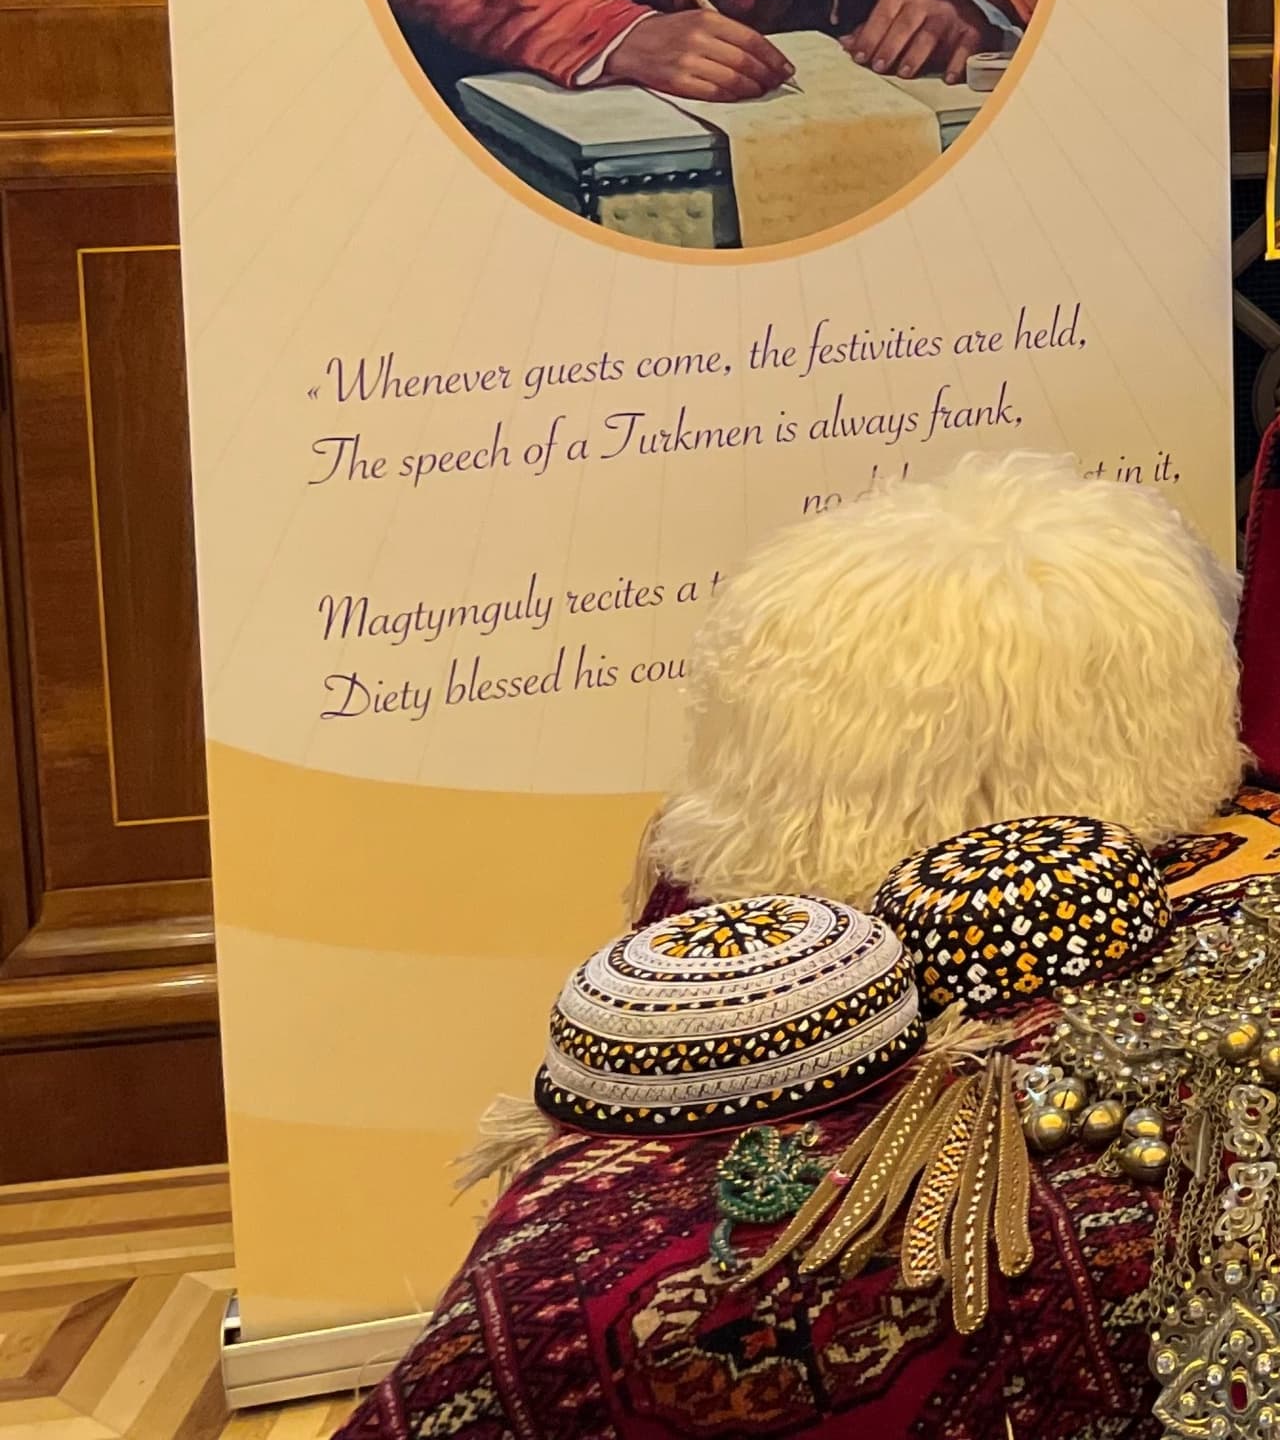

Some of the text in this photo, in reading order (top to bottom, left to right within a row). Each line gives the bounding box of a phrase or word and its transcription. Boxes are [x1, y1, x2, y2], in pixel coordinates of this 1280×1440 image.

[524, 352, 624, 399] guests
[637, 353, 731, 378] come,
[750, 323, 797, 370] the
[799, 319, 943, 378] festivities
[954, 329, 1003, 355] are
[1014, 302, 1087, 350] held,
[308, 381, 1023, 488] The speech of a Turkmen is always frank,
[1116, 455, 1144, 484] in
[1153, 451, 1181, 484] it,
[318, 572, 553, 646] Magtymguly
[567, 577, 664, 614] recites
[677, 578, 698, 602] a
[320, 672, 432, 721] Diety
[446, 646, 565, 704] blessed
[574, 644, 618, 690] his
